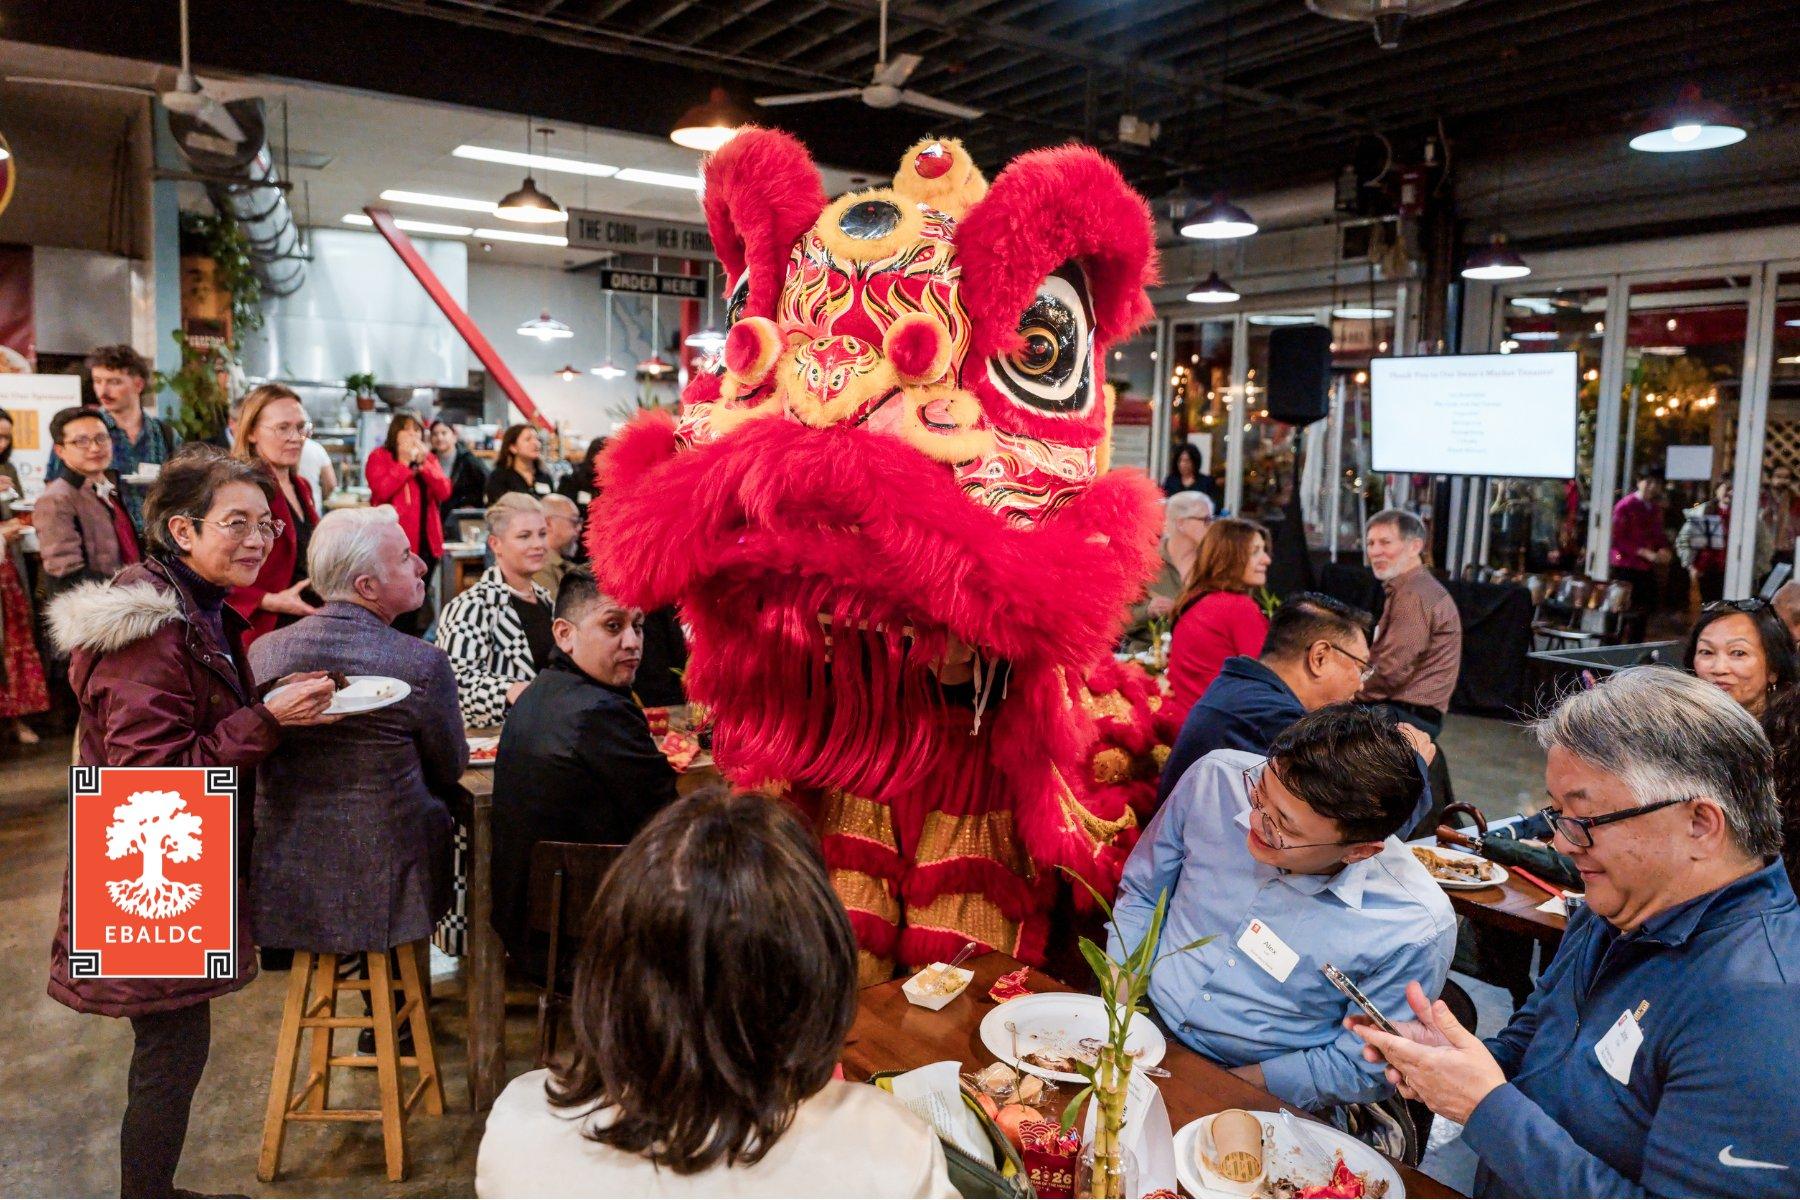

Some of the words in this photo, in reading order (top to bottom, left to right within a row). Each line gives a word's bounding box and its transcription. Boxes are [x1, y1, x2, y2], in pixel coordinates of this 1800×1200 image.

[579, 218, 601, 241] THE
[610, 273, 658, 290] ORDER
[661, 279, 698, 296] HERE
